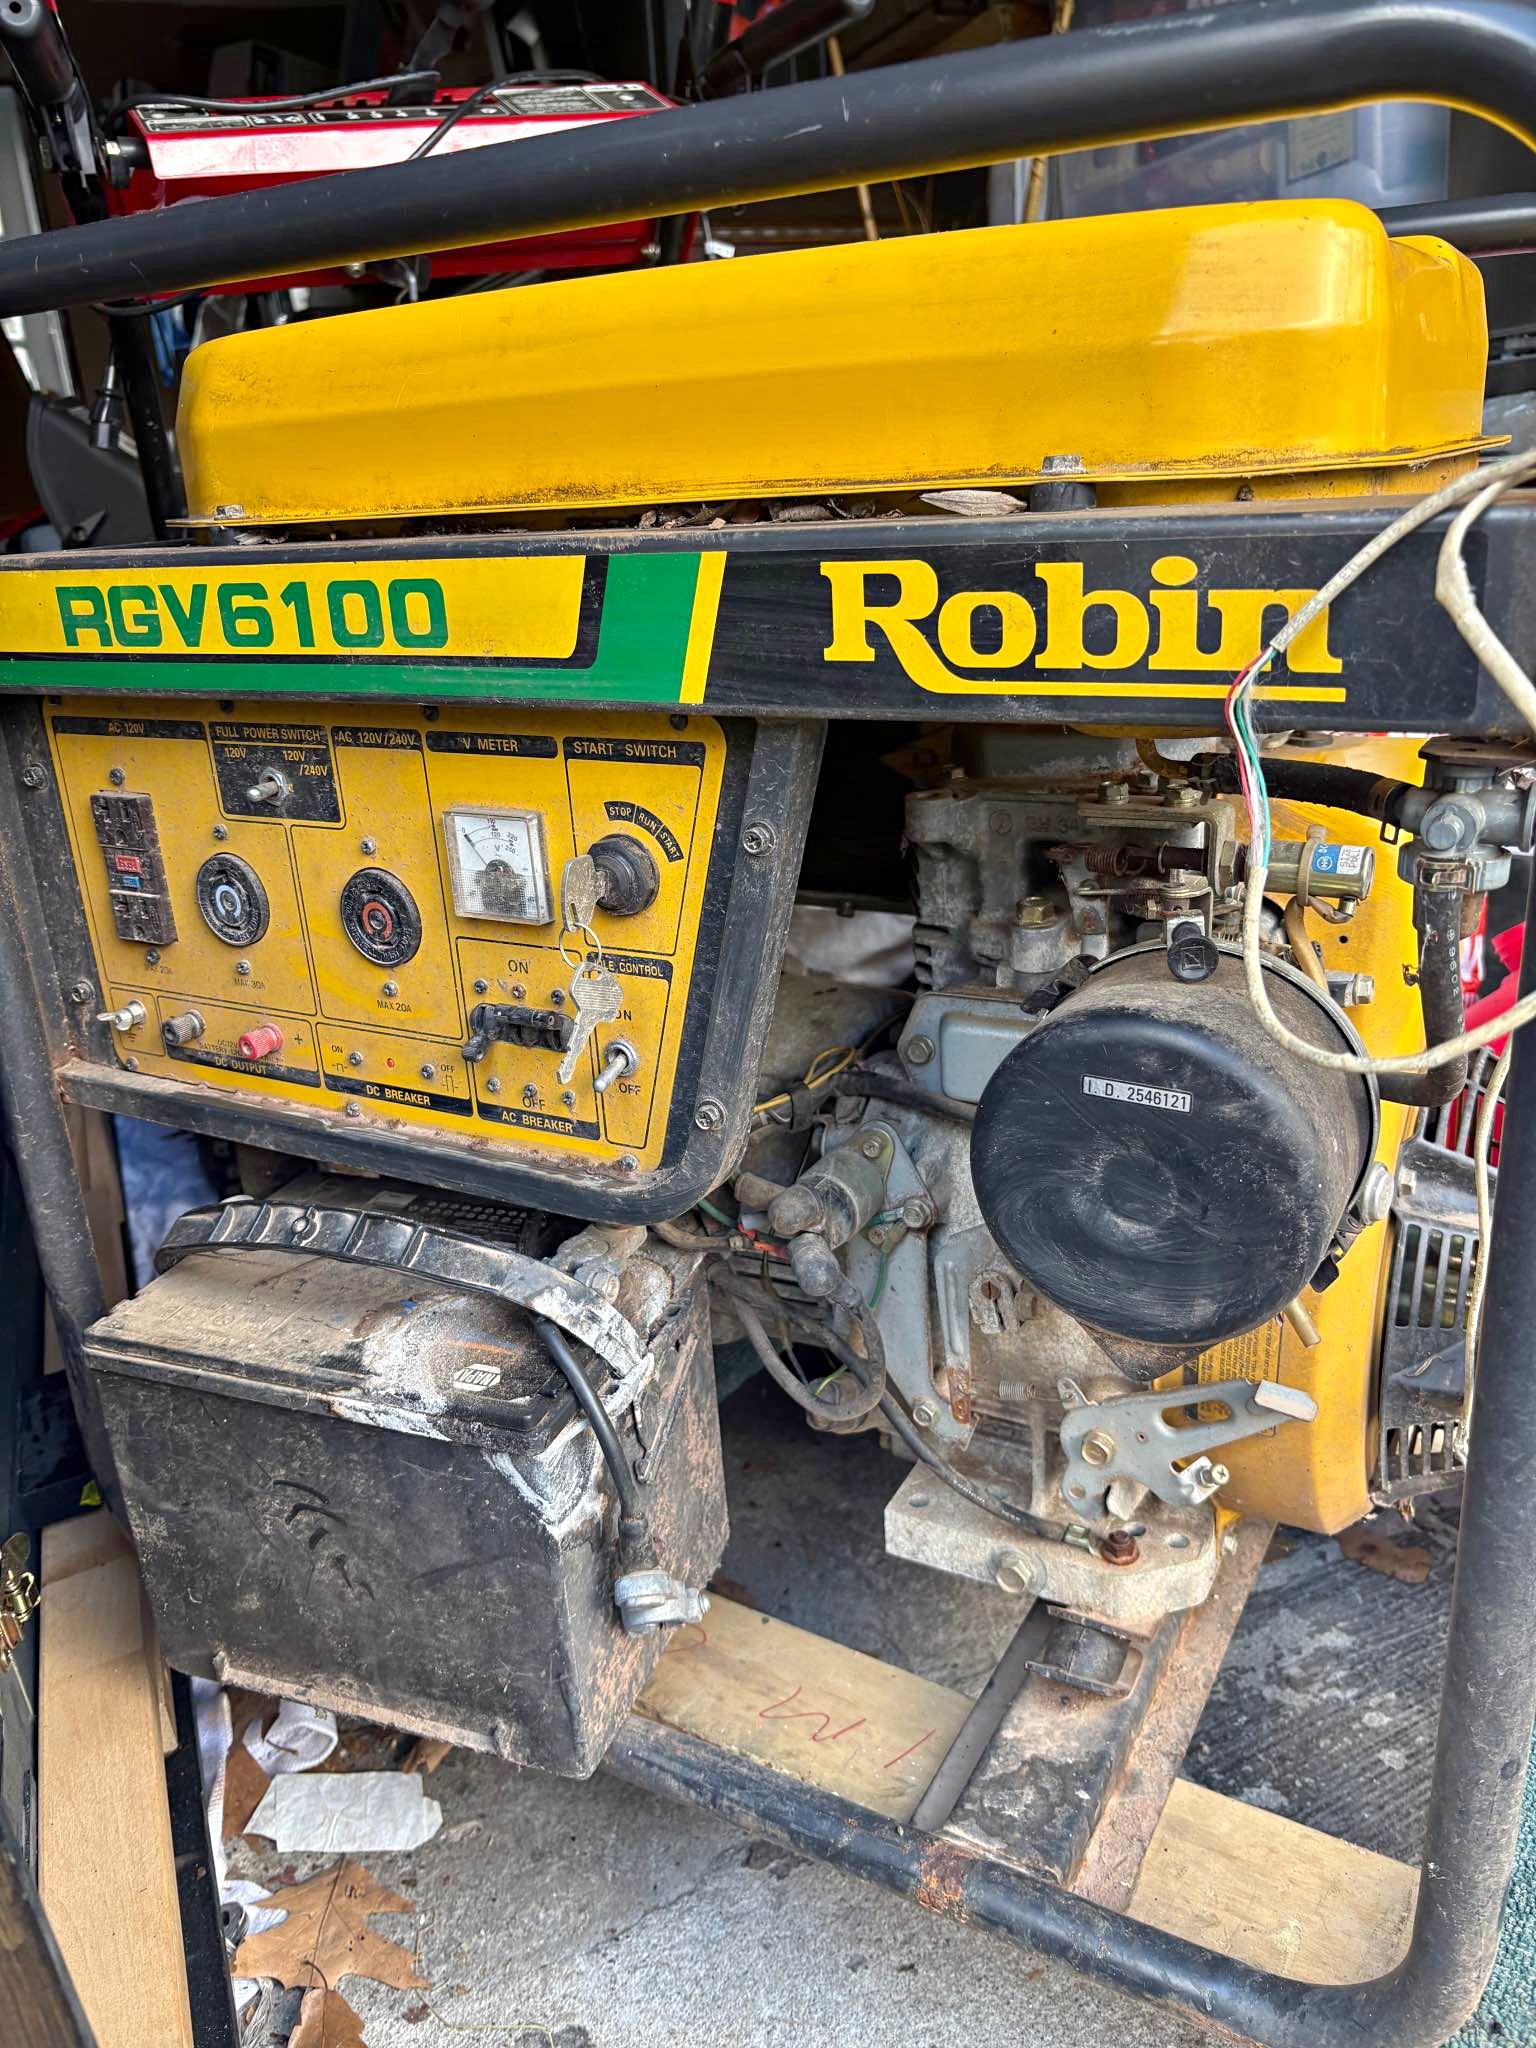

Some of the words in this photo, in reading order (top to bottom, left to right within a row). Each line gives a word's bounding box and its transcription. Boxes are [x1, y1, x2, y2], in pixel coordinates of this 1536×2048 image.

[55, 578, 449, 649] RGV6100
[819, 556, 1344, 694] Robin
[108, 722, 121, 733] AC
[125, 723, 144, 734] 120V
[215, 726, 239, 738] FULL
[244, 727, 279, 740] POWER
[281, 728, 320, 741] SWITCH
[337, 731, 352, 743] AC
[225, 747, 246, 758] 120V
[464, 739, 471, 749] V
[477, 738, 519, 753] METER
[573, 741, 614, 756] START
[625, 743, 677, 759] SWITCH
[283, 750, 305, 762] 120V
[609, 806, 632, 817] STOP
[638, 812, 657, 830] RUN
[660, 831, 680, 859] START
[507, 959, 529, 974] ON
[619, 961, 664, 977] CONTROL
[331, 1044, 343, 1054] ON
[215, 1056, 228, 1067] DC
[231, 1060, 267, 1075] OUTPUT
[440, 1063, 455, 1072] OFF
[366, 1084, 381, 1096] DC
[384, 1088, 431, 1106] BREAKER
[619, 1082, 641, 1095] OFF
[522, 1096, 546, 1111] OFF
[1127, 1086, 1187, 1110] 2546121
[502, 1110, 517, 1123] AC
[522, 1112, 574, 1133] BREAKER
